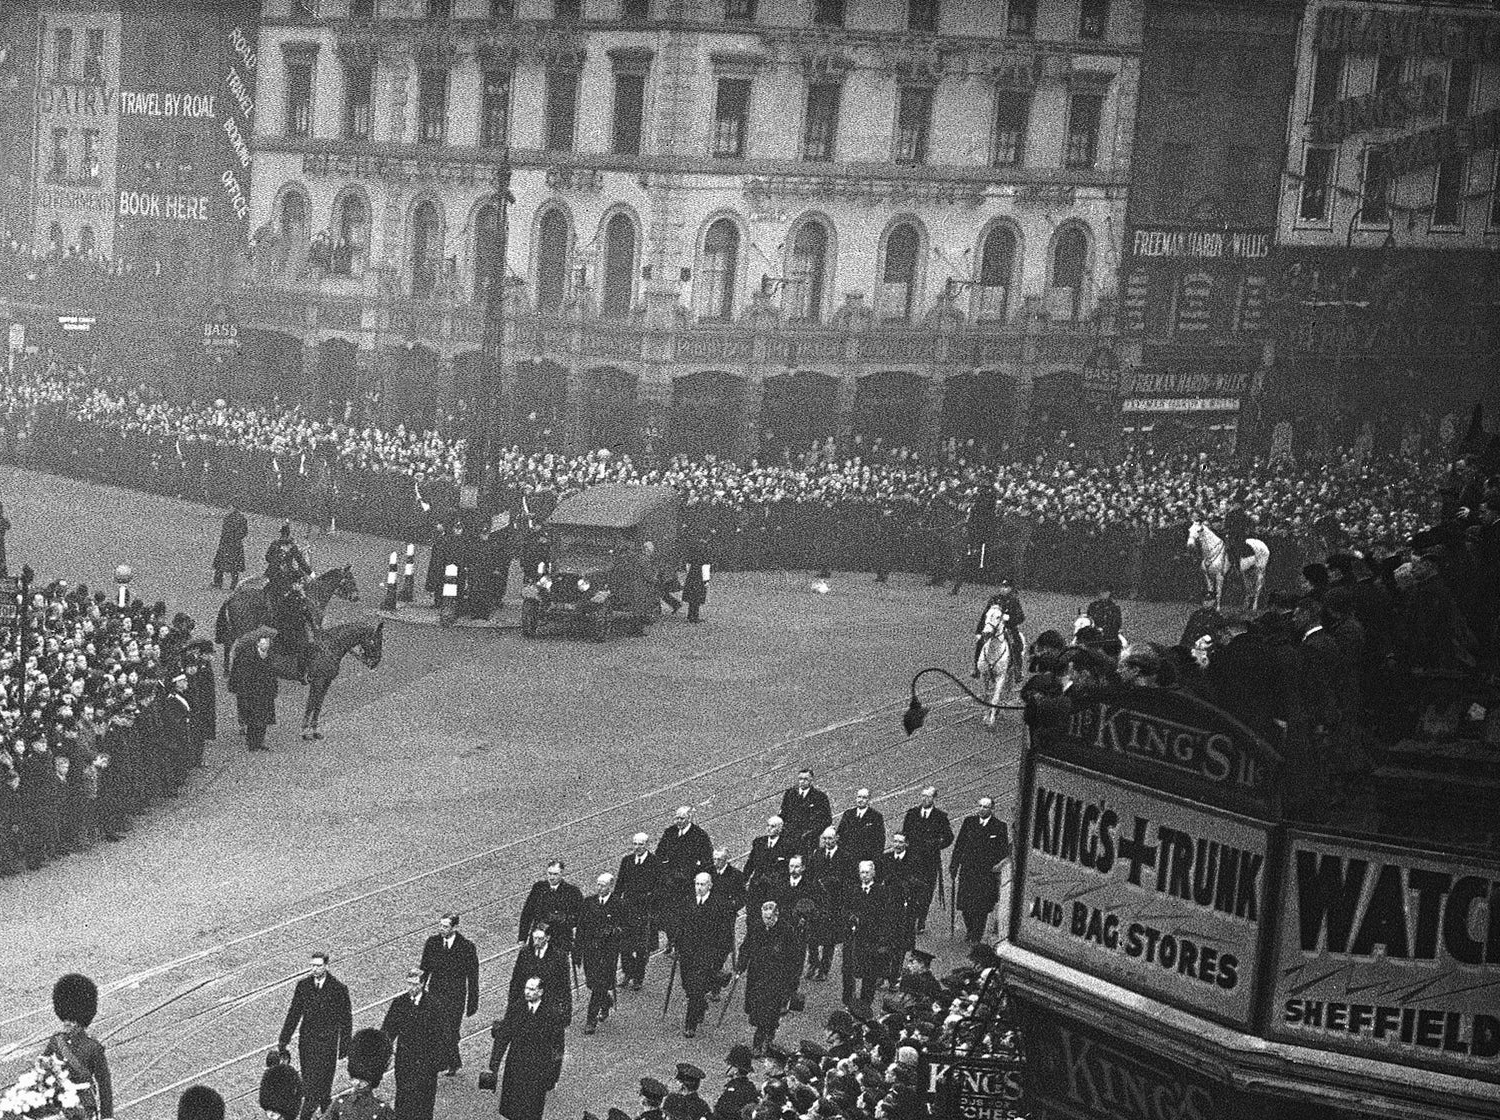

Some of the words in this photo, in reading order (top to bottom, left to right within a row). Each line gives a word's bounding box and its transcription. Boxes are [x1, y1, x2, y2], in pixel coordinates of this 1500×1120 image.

[228, 27, 257, 69] ROAD
[121, 91, 161, 116] TRAVEL
[164, 93, 181, 117] BY
[225, 66, 254, 119] TRAVEL
[119, 191, 160, 218] BOOK
[165, 195, 208, 221] HERE
[221, 170, 249, 220] OFFICE
[1133, 229, 1184, 257] FREEMAN
[1187, 231, 1223, 258] HARDY
[1233, 231, 1269, 259] WILLIS
[1084, 366, 1119, 383] BASS
[1030, 786, 1119, 875] KING'S
[1156, 825, 1266, 922] TRUNK
[1293, 848, 1500, 967] WATC
[1030, 895, 1064, 928] AND
[1070, 901, 1120, 950] BAG
[1125, 922, 1240, 990] STORES
[1285, 1000, 1500, 1059] SHEFFIELD
